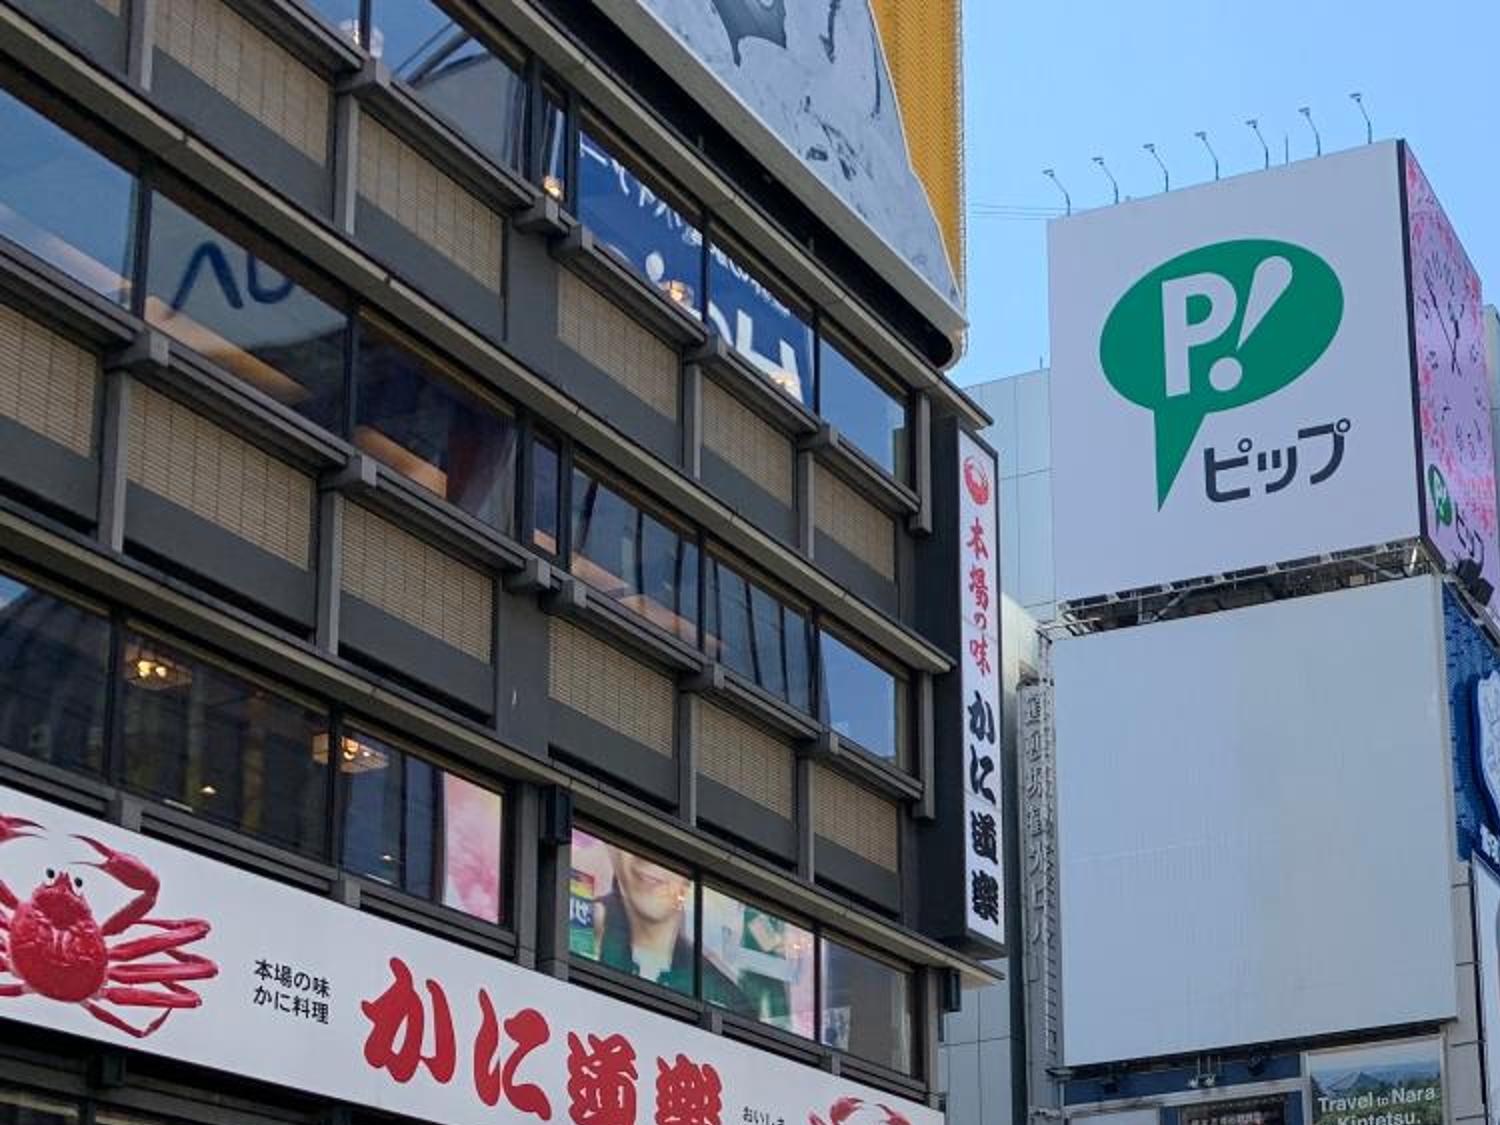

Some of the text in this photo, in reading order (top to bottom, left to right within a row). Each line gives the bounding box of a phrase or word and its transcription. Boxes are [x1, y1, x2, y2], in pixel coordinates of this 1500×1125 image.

[1204, 417, 1351, 503] ピップ
[967, 516, 991, 675] 本場の味
[254, 958, 331, 998] 本場の味
[253, 984, 329, 1025] かに料理
[1317, 1087, 1436, 1113] Travel to Nara
